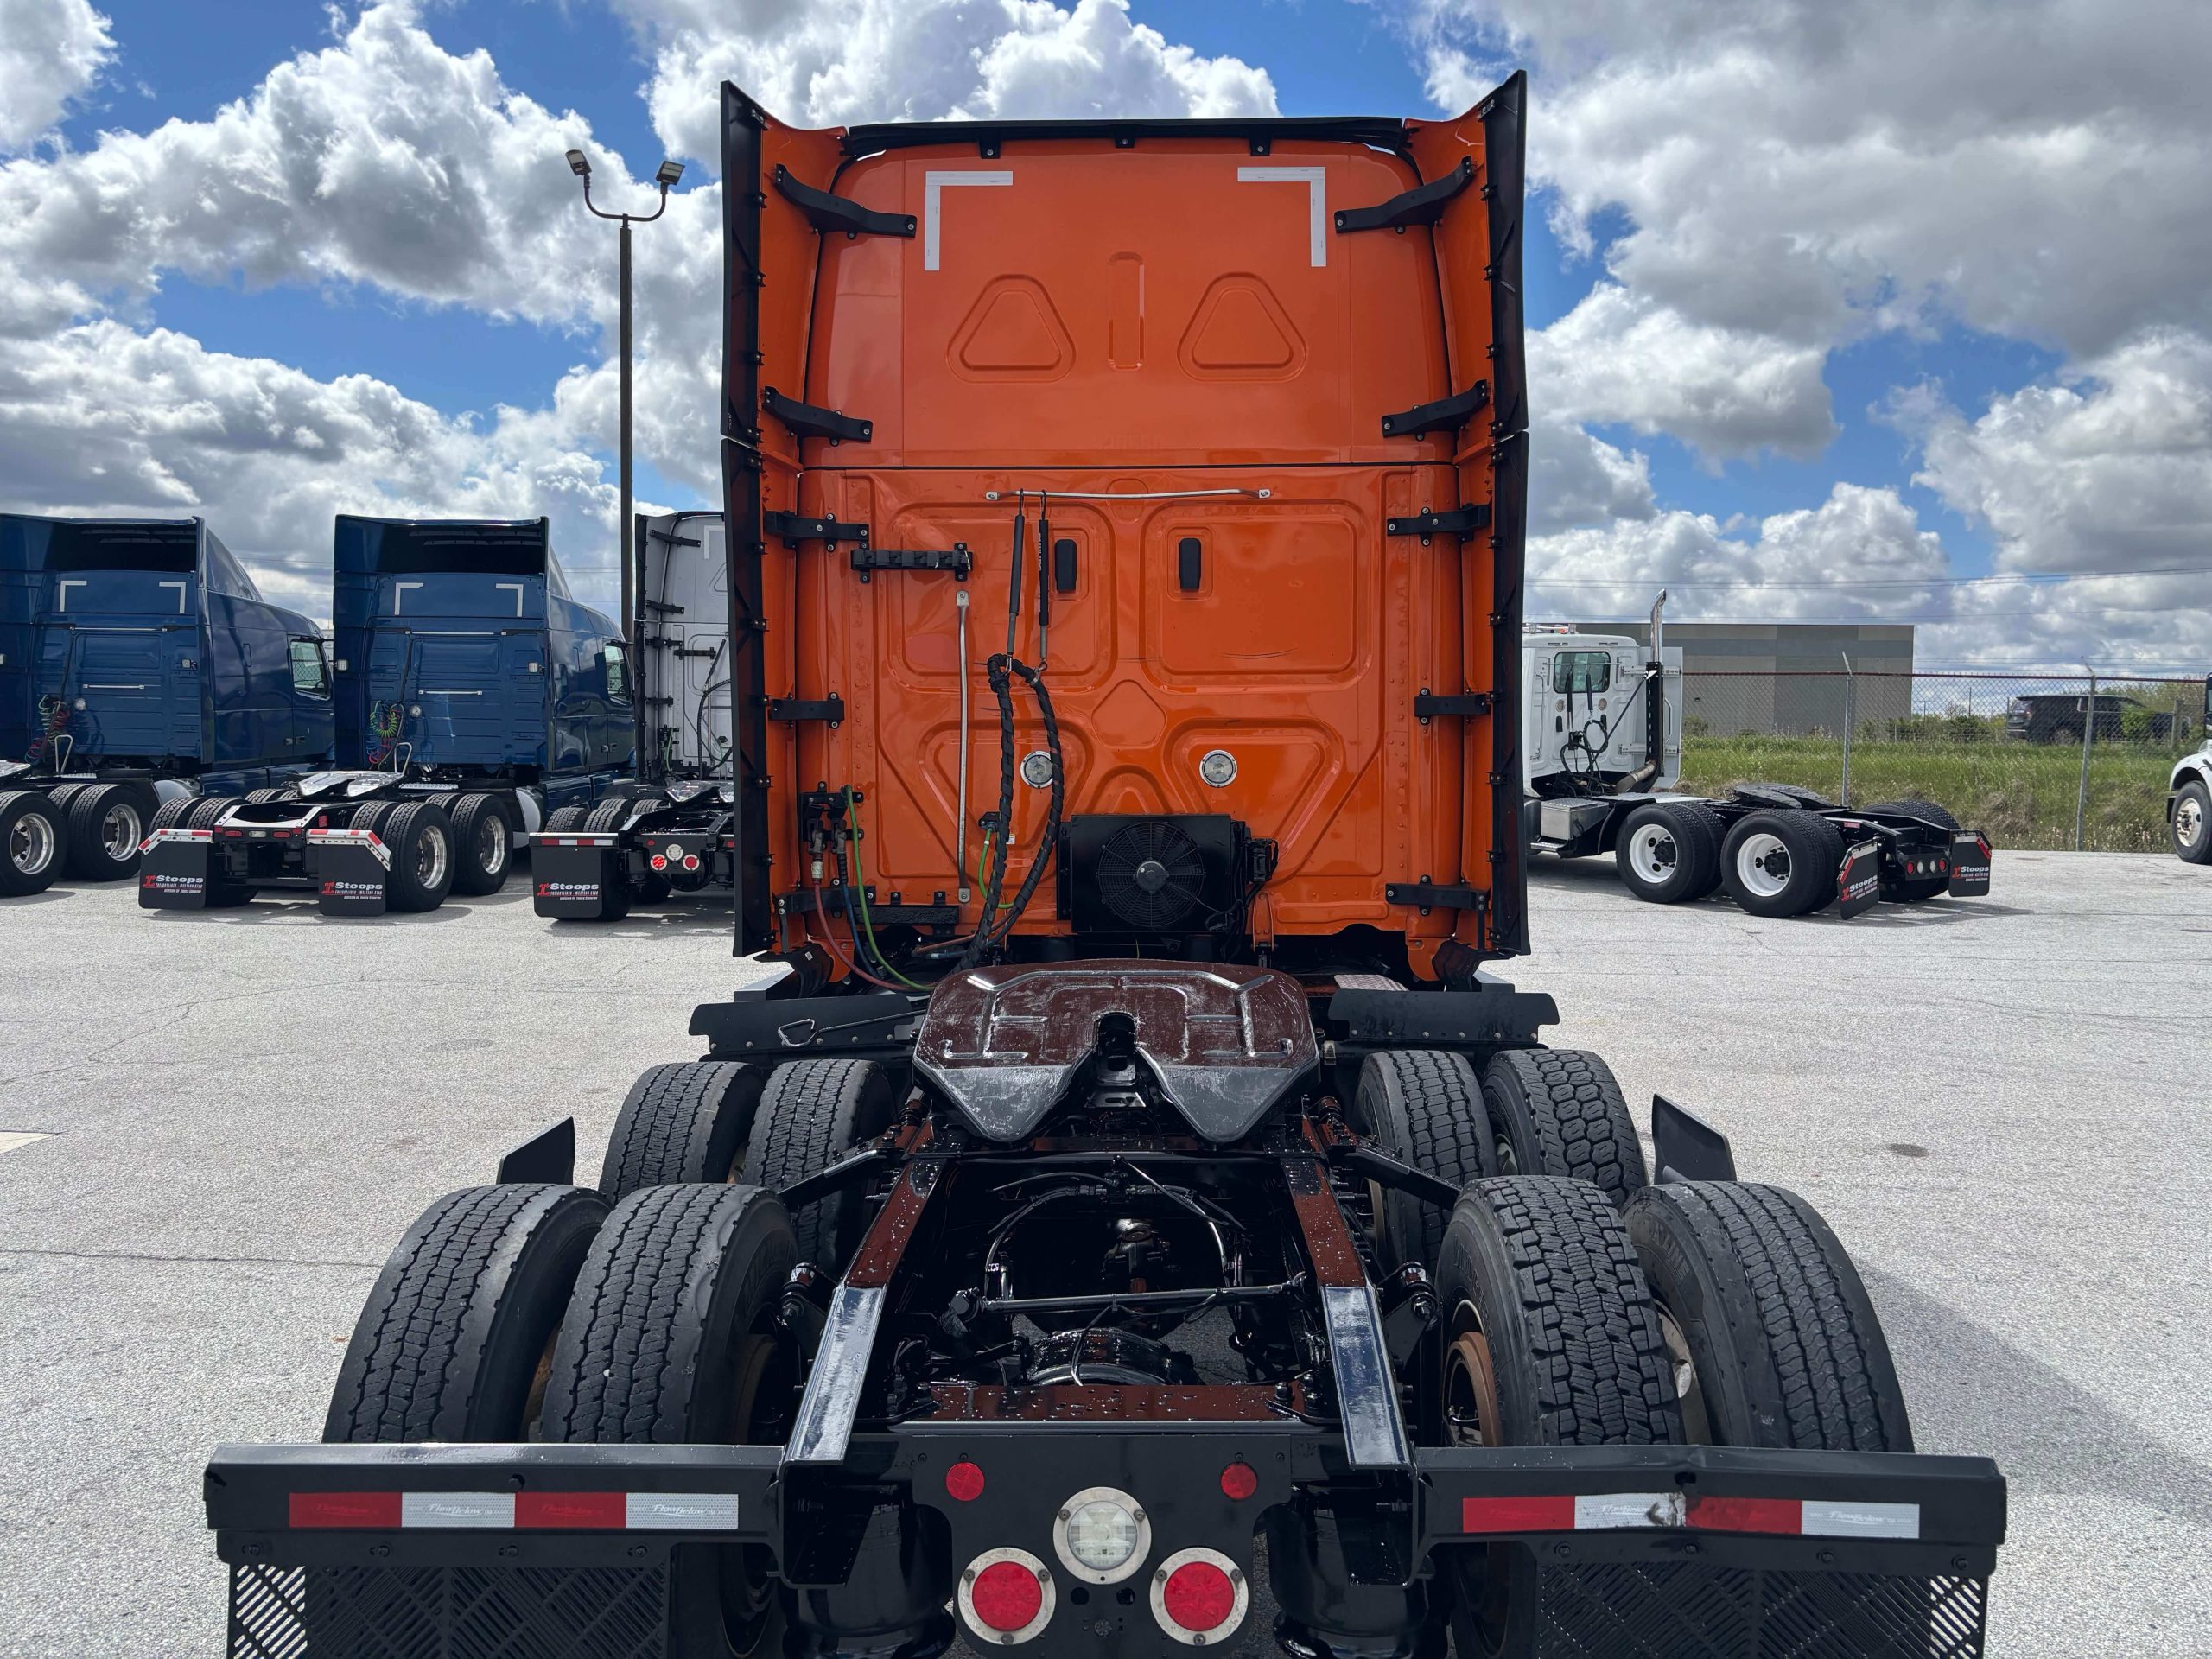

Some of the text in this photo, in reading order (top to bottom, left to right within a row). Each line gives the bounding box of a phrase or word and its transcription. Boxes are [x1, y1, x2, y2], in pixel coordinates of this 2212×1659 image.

[156, 874, 204, 884] Stoops
[1849, 874, 1878, 892] Stoops
[334, 881, 383, 891] Stoops
[550, 882, 599, 891] Stoops
[652, 1503, 707, 1516] FlowBelow
